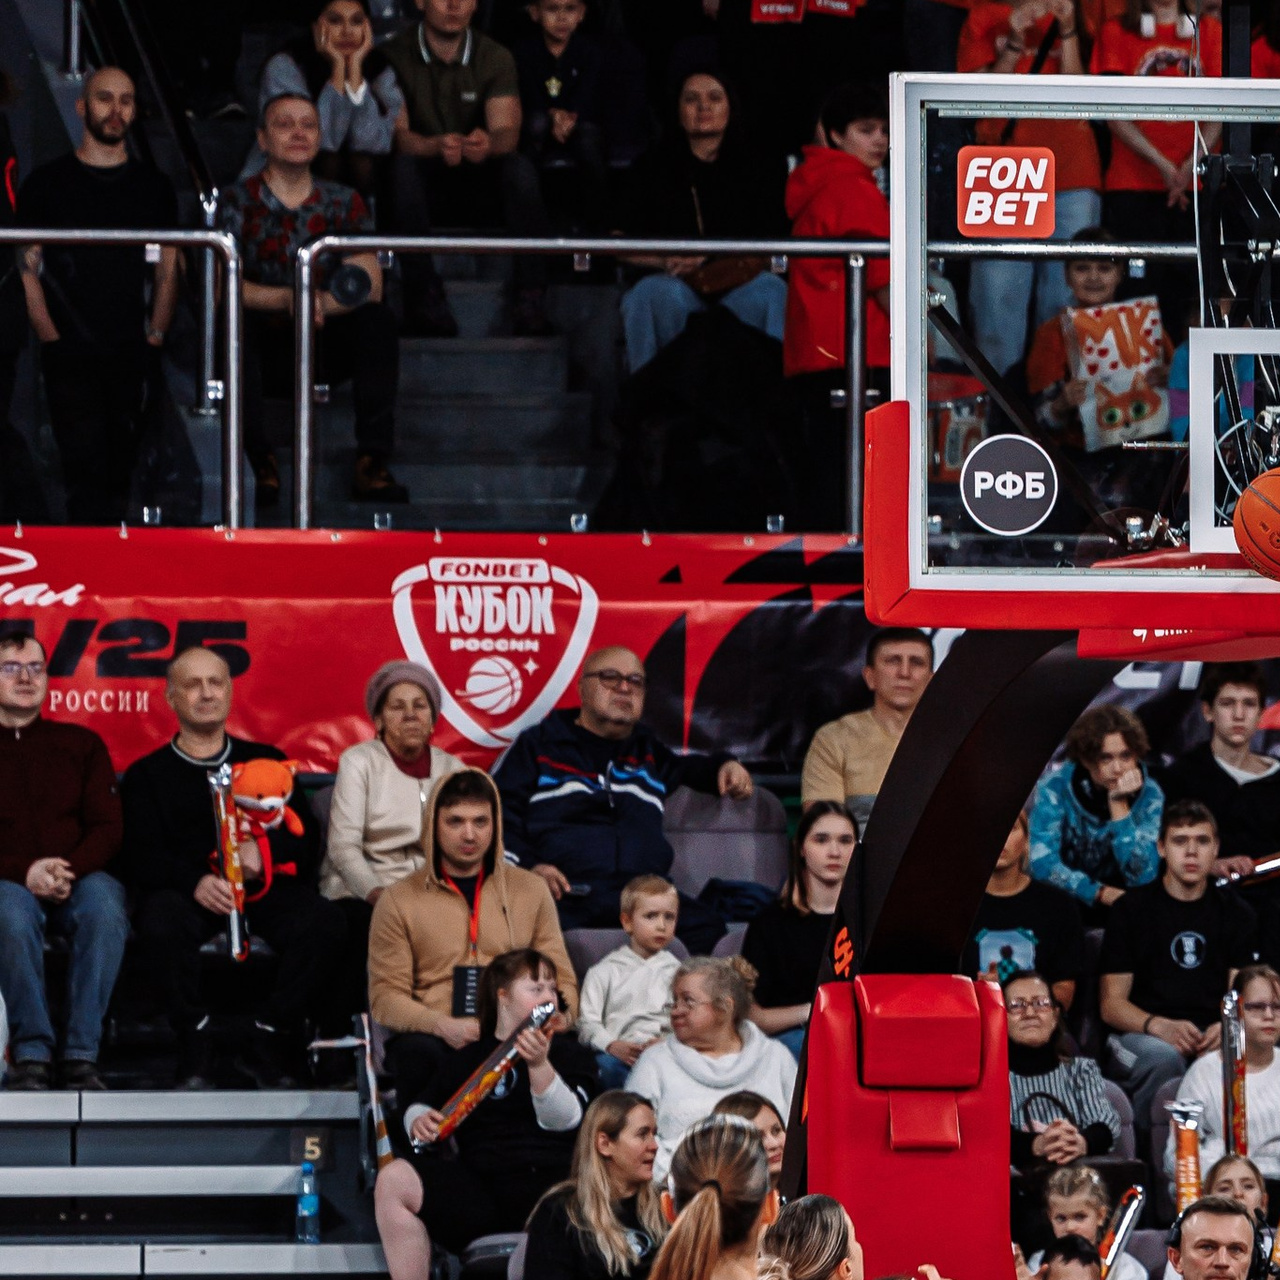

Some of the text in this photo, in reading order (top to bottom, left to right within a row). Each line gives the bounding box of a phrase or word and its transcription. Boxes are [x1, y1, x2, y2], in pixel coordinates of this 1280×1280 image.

[964, 157, 1048, 190] FON
[964, 192, 1048, 226] BET
[973, 470, 1046, 500] РФБ
[440, 562, 539, 578] FONBET
[434, 584, 556, 635] КУБОК
[50, 689, 150, 713] РОССИИ
[304, 1136, 321, 1160] 5
